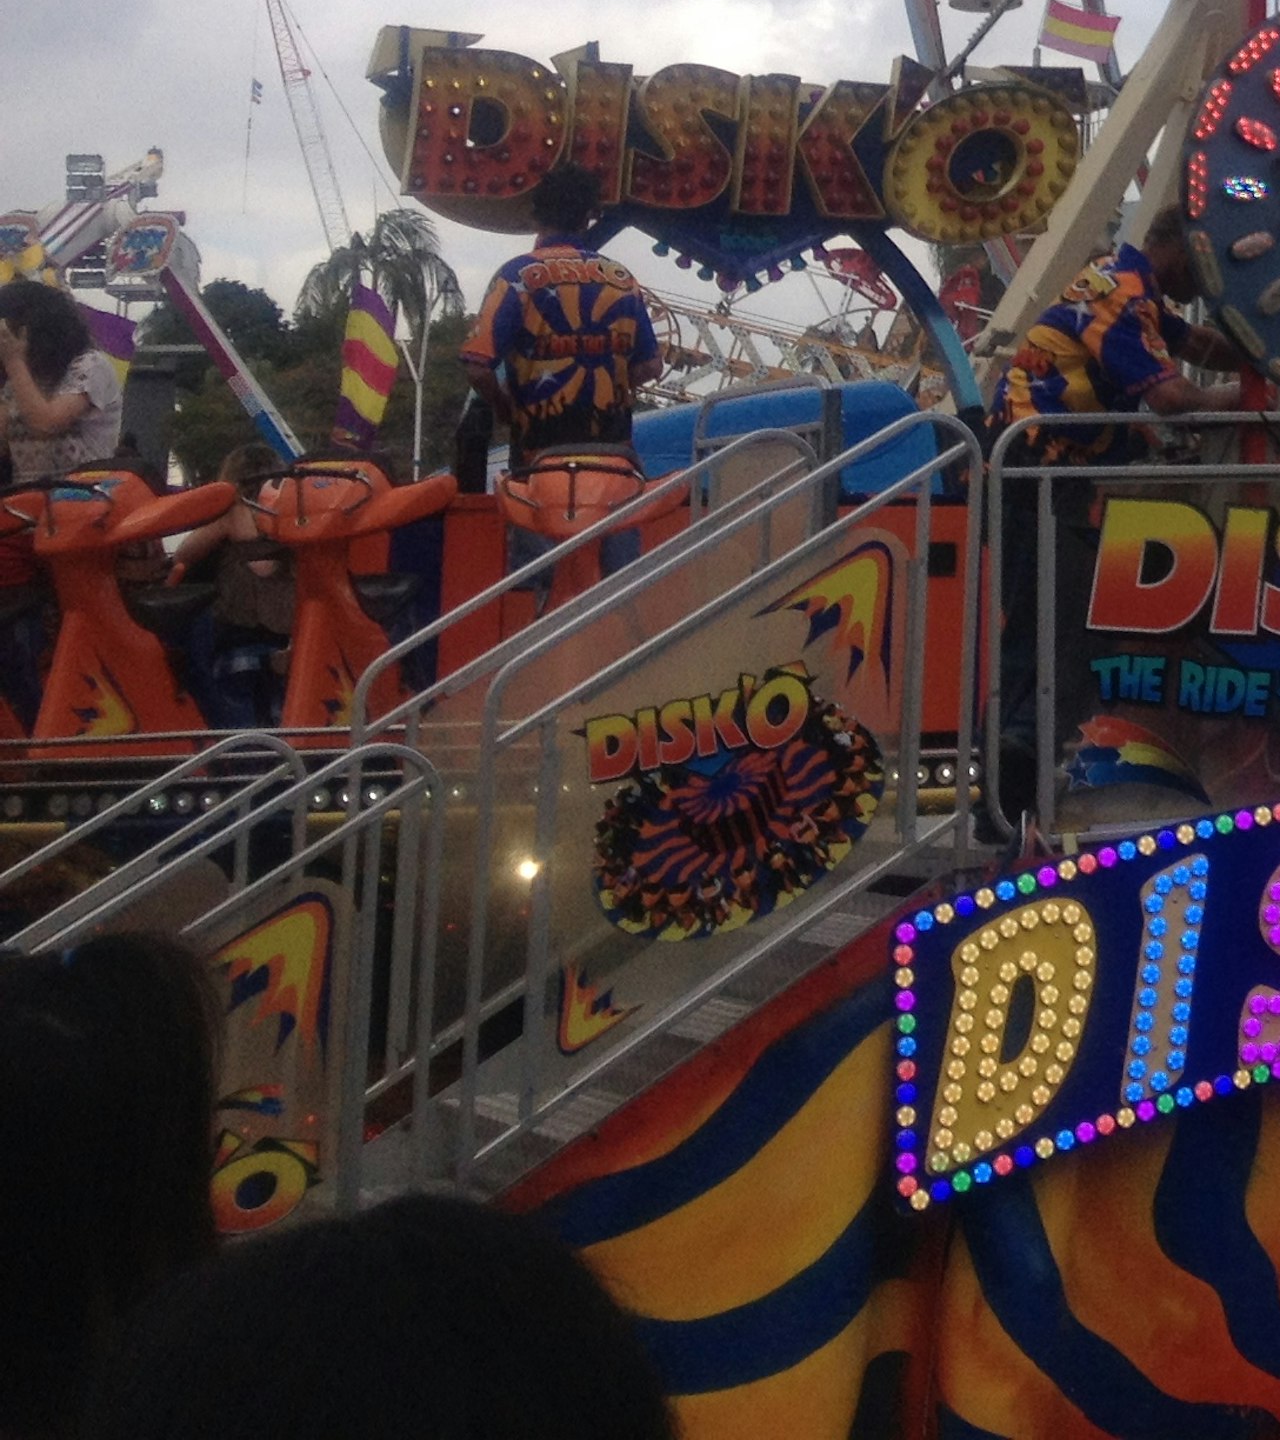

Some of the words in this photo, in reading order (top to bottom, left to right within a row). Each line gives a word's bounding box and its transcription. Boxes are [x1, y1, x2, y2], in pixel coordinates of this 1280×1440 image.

[585, 672, 809, 782] DISK'O
[1090, 655, 1168, 704] THE
[1180, 659, 1271, 717] RIDE
